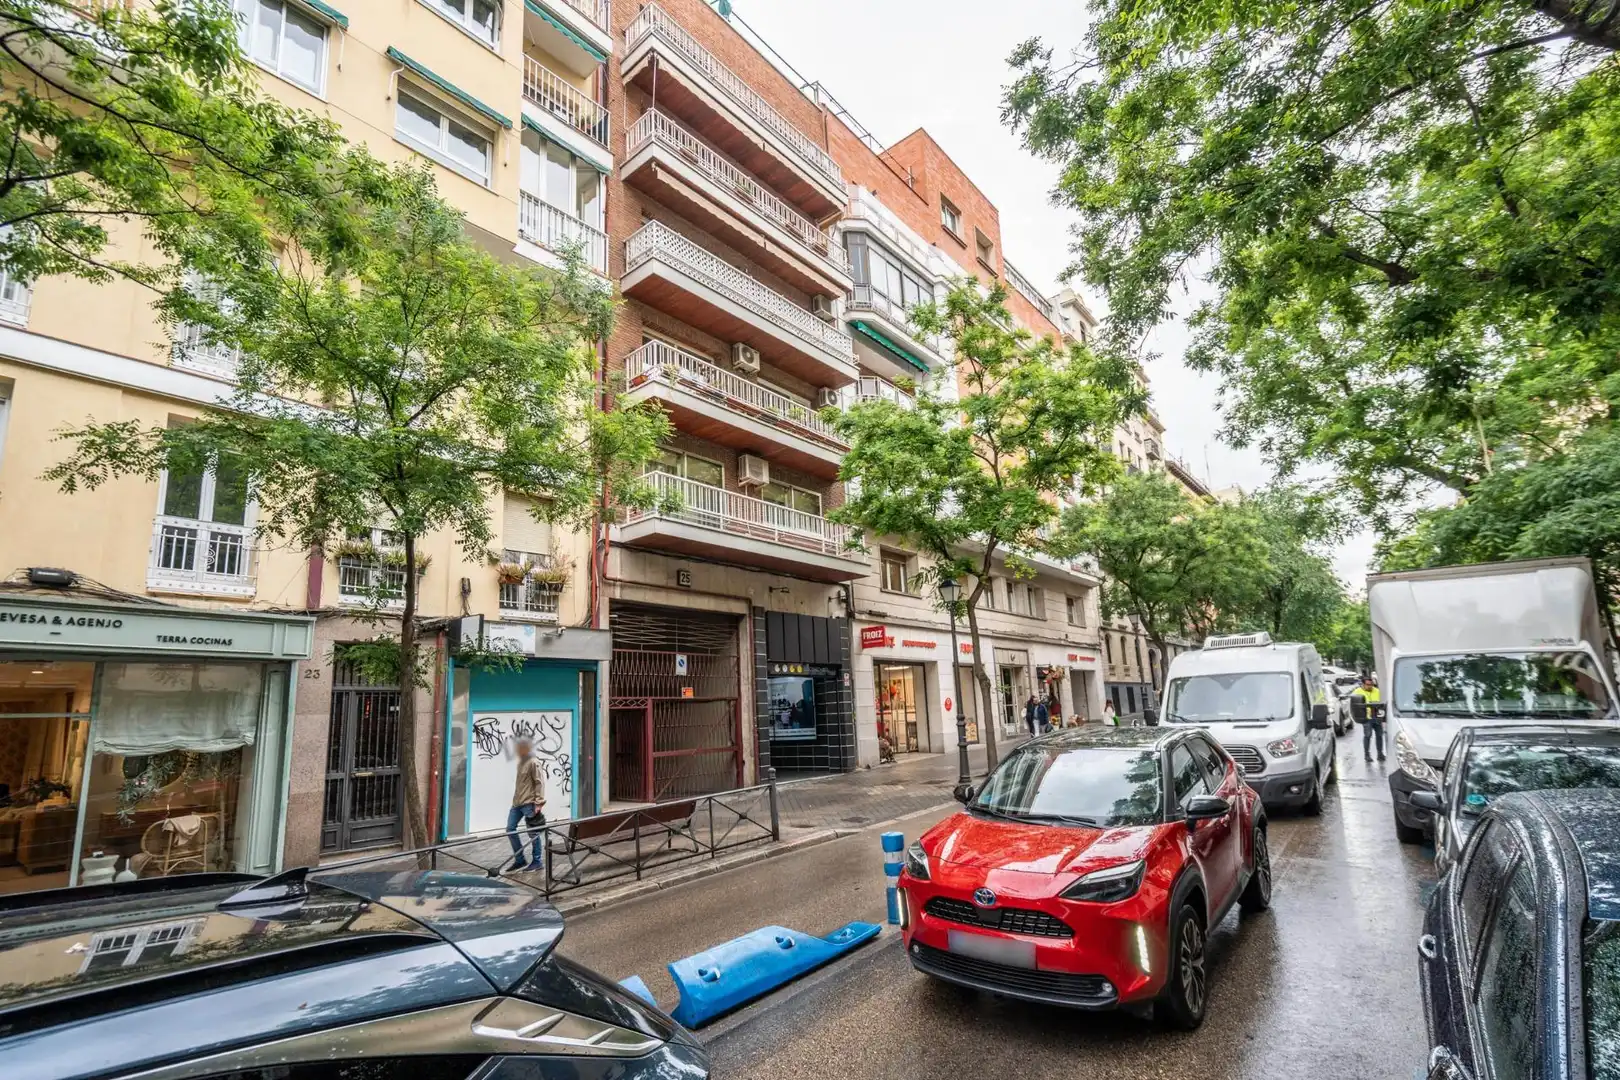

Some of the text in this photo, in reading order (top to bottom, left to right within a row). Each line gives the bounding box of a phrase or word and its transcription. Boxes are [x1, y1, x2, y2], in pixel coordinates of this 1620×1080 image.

[681, 573, 691, 583] 25
[51, 615, 62, 625] &
[65, 616, 123, 629] AGENJO
[156, 635, 233, 646] TERRA COCINAS
[304, 669, 320, 679] 23
